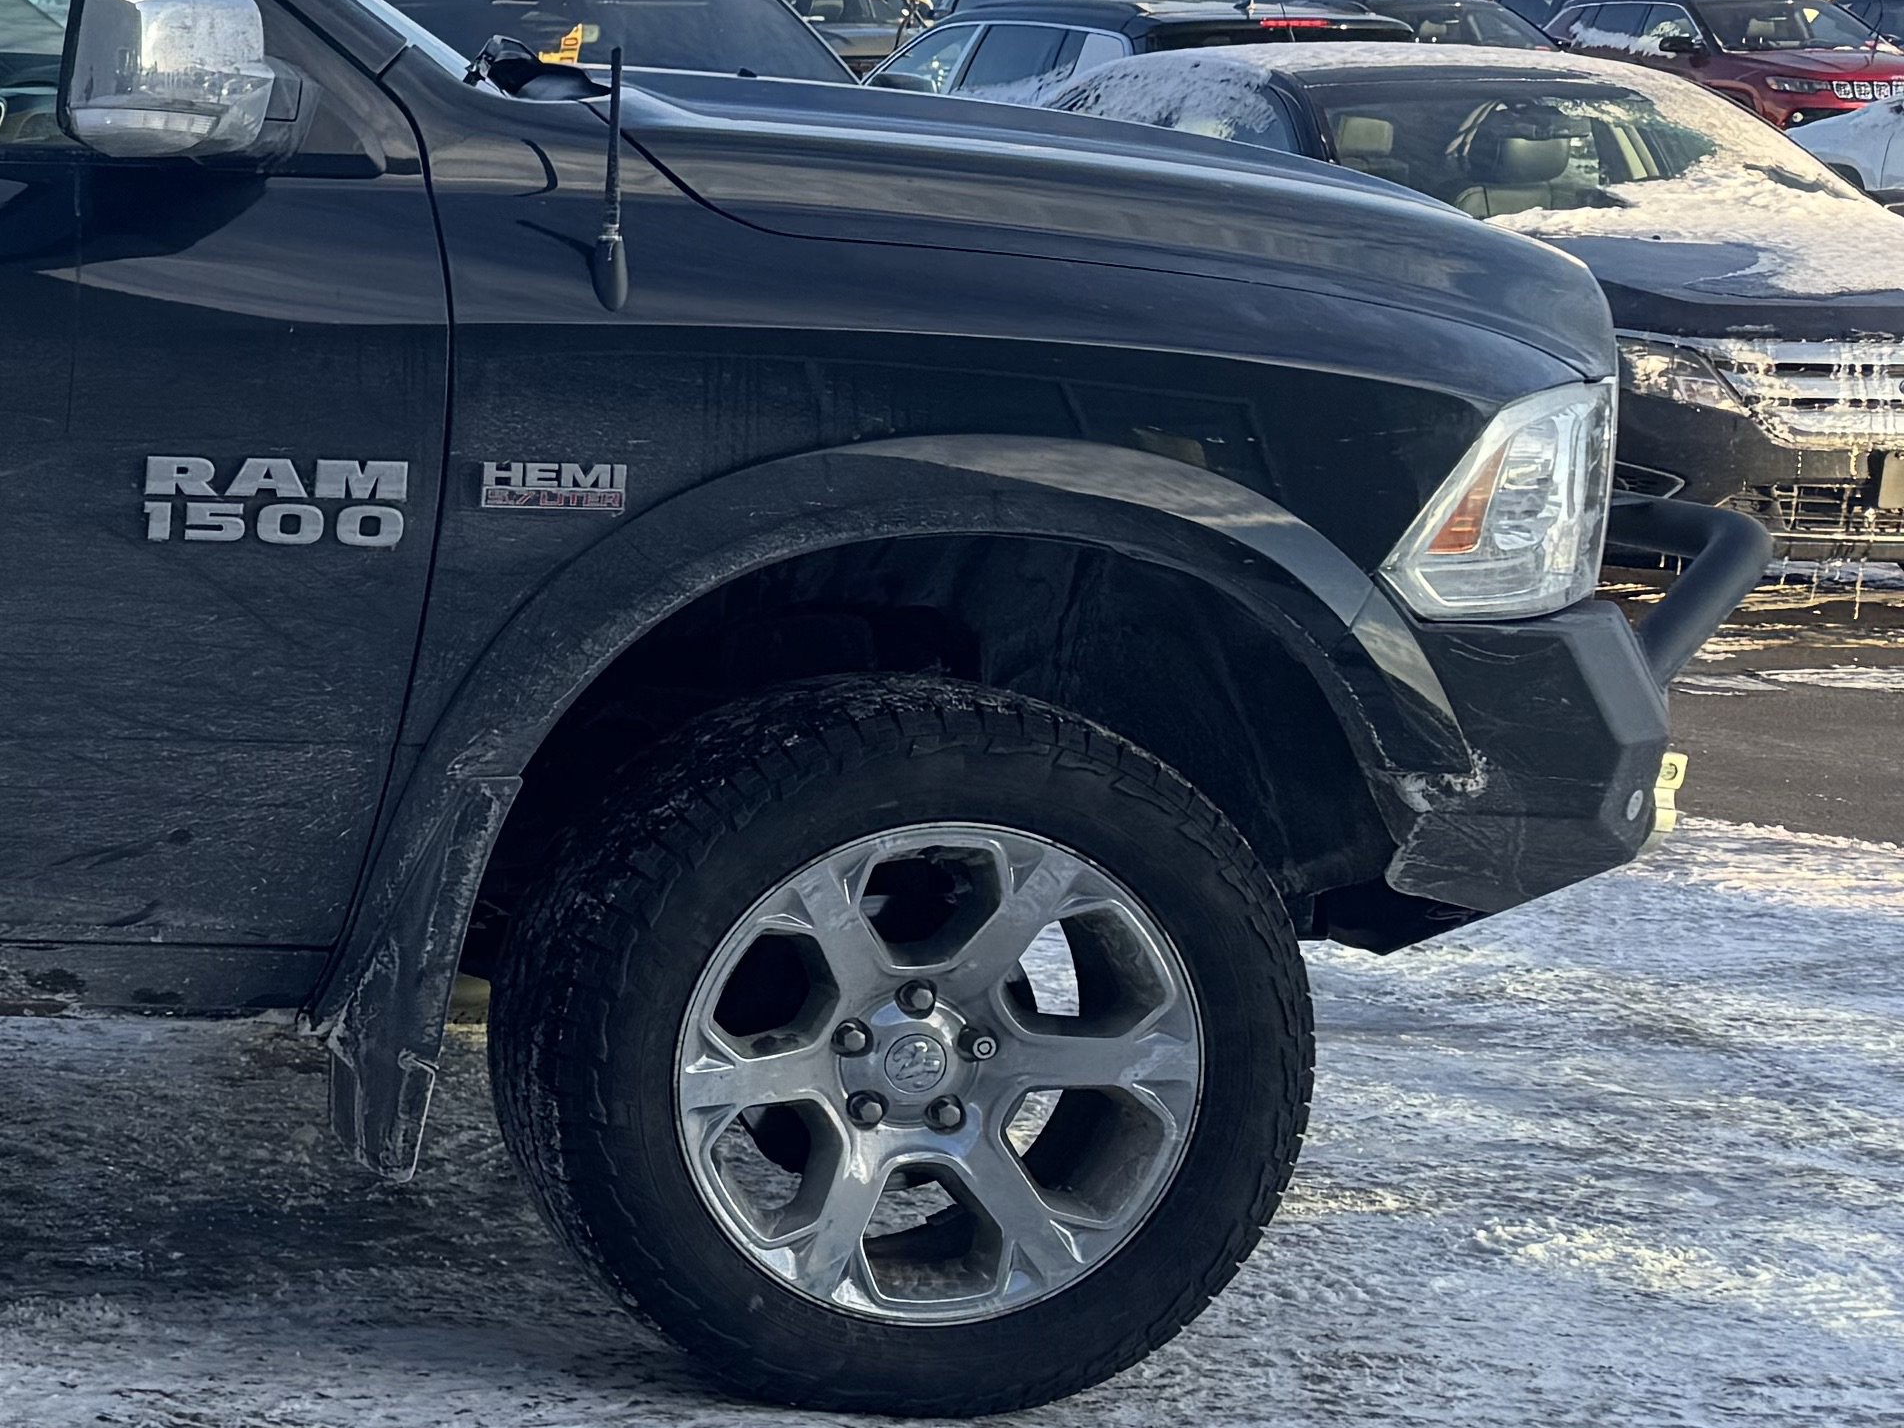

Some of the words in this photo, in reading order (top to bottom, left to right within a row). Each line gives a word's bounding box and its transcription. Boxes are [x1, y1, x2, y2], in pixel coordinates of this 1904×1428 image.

[144, 455, 409, 500] RAM
[483, 461, 627, 490] HEMI
[539, 490, 621, 508] LITER
[144, 501, 405, 547] 1500
